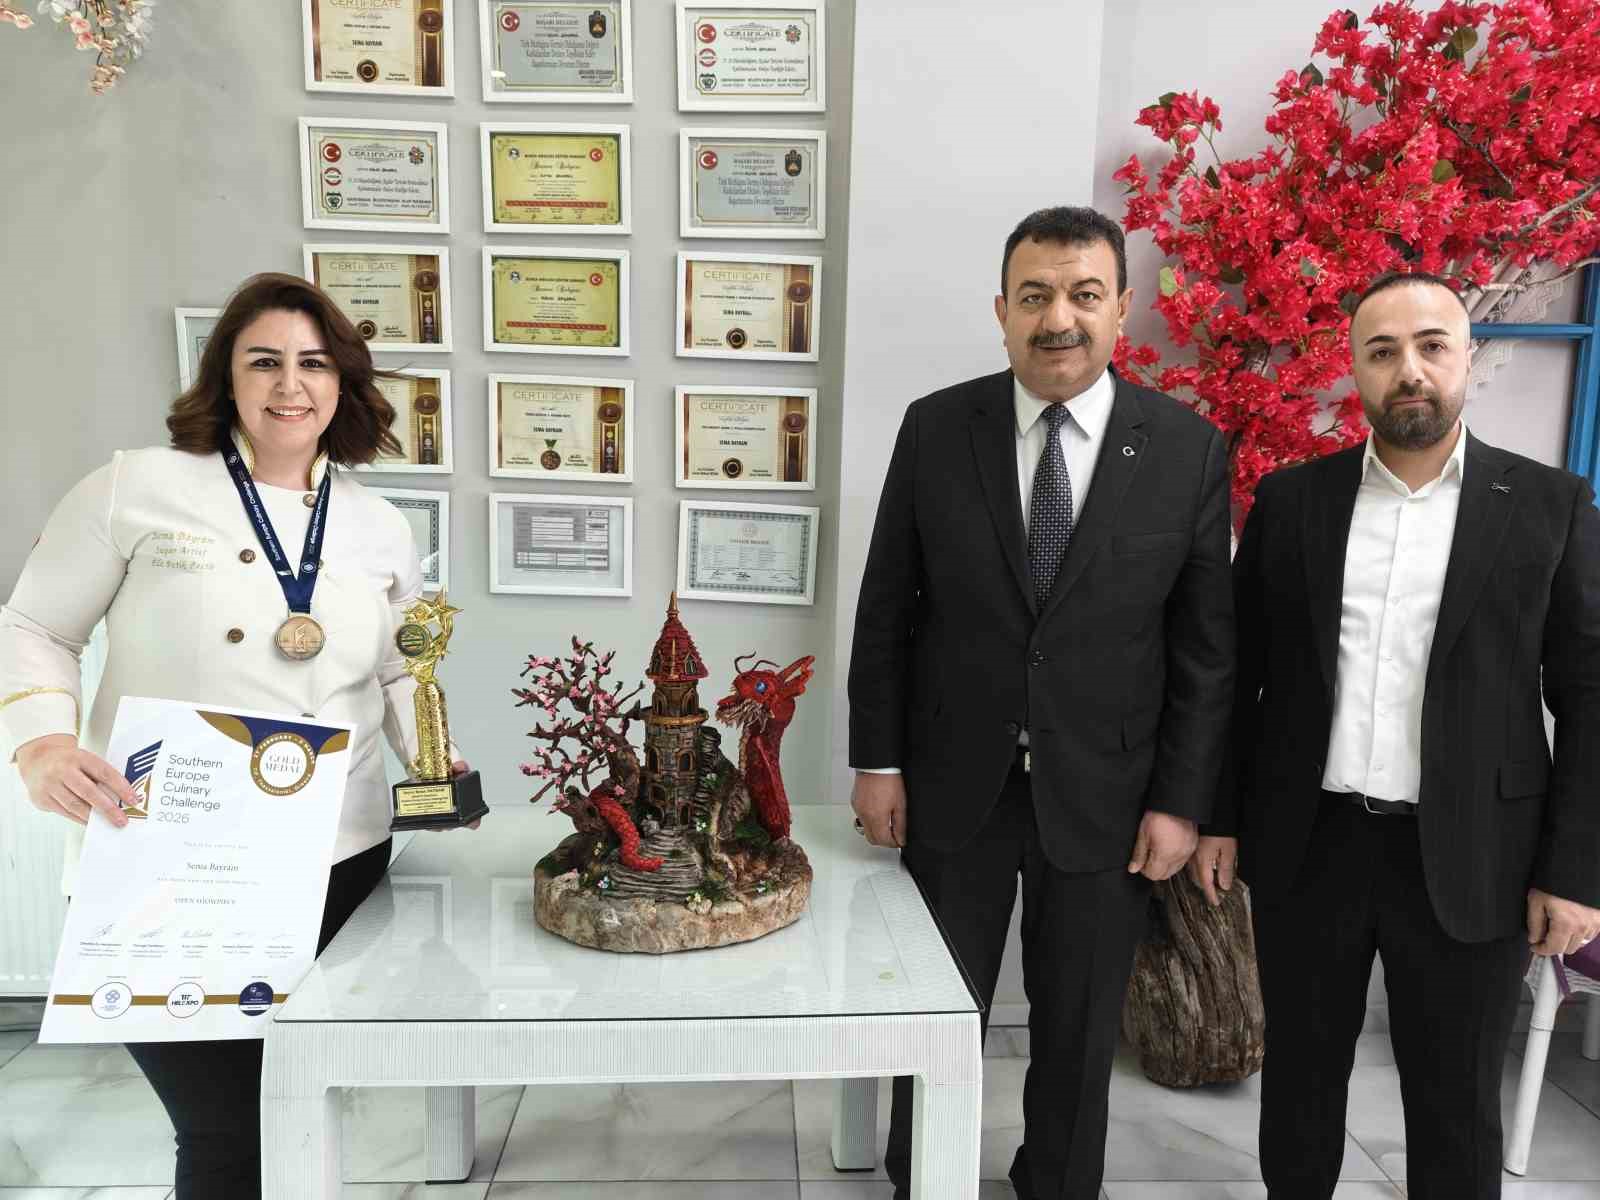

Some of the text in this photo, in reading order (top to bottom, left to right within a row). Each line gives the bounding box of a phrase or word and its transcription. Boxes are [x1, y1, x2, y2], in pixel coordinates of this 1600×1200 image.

[329, 261, 400, 272] CERTIFICATE
[703, 270, 773, 281] CERTIFICATE
[513, 391, 583, 401] CERTIFICATE
[700, 401, 769, 412] CERTIFICATE
[168, 754, 223, 769] Southern
[269, 755, 300, 764] GOLD
[166, 768, 211, 782] Europe
[163, 781, 212, 798] Culinary
[160, 795, 221, 811] Challenge
[157, 811, 190, 824] 2026
